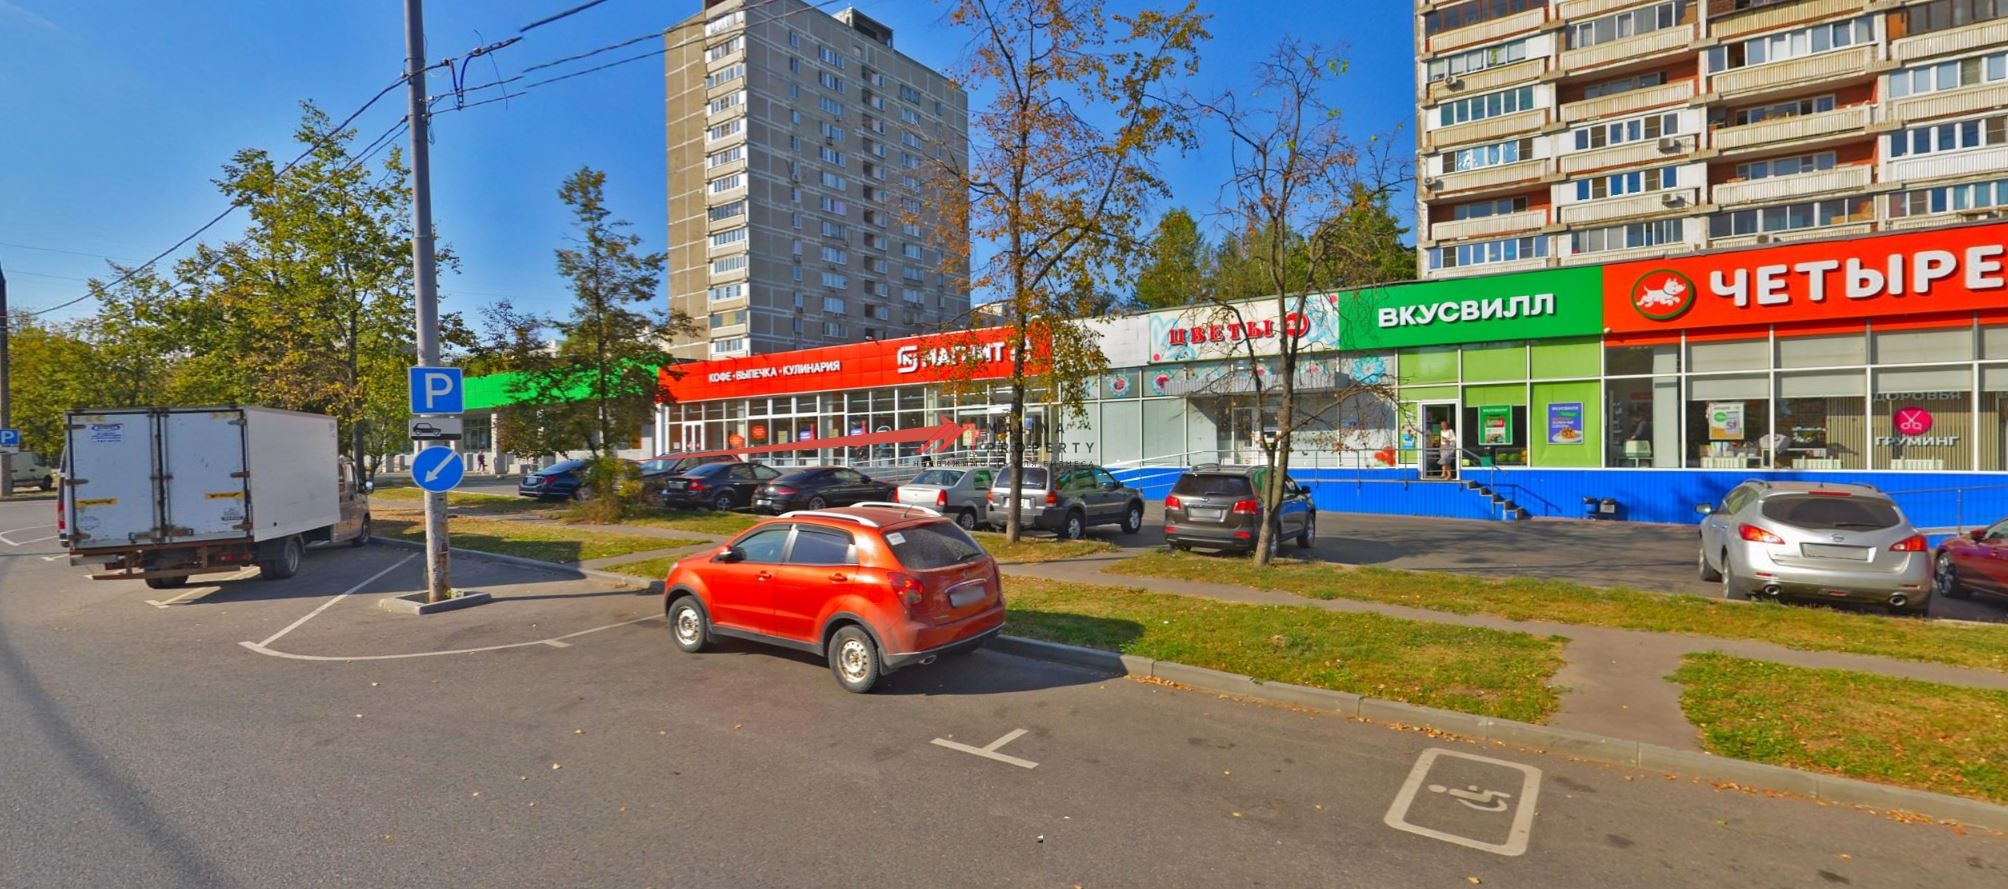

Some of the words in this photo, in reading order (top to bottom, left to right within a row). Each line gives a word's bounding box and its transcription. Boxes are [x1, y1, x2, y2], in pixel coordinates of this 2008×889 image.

[1709, 244, 2004, 307] ЧЕТЫРЕ
[1379, 293, 1554, 327] ВКУСВИЛЛ
[1169, 320, 1273, 346] ЦВЕТЫ
[709, 372, 732, 382] КОФЕ
[736, 367, 777, 380] ВЫПЕЧКА
[783, 361, 840, 375] КУЛИНАРИЯ
[424, 372, 453, 408] P
[1, 431, 14, 443] P
[1876, 436, 1959, 446] ГРУМИНГ
